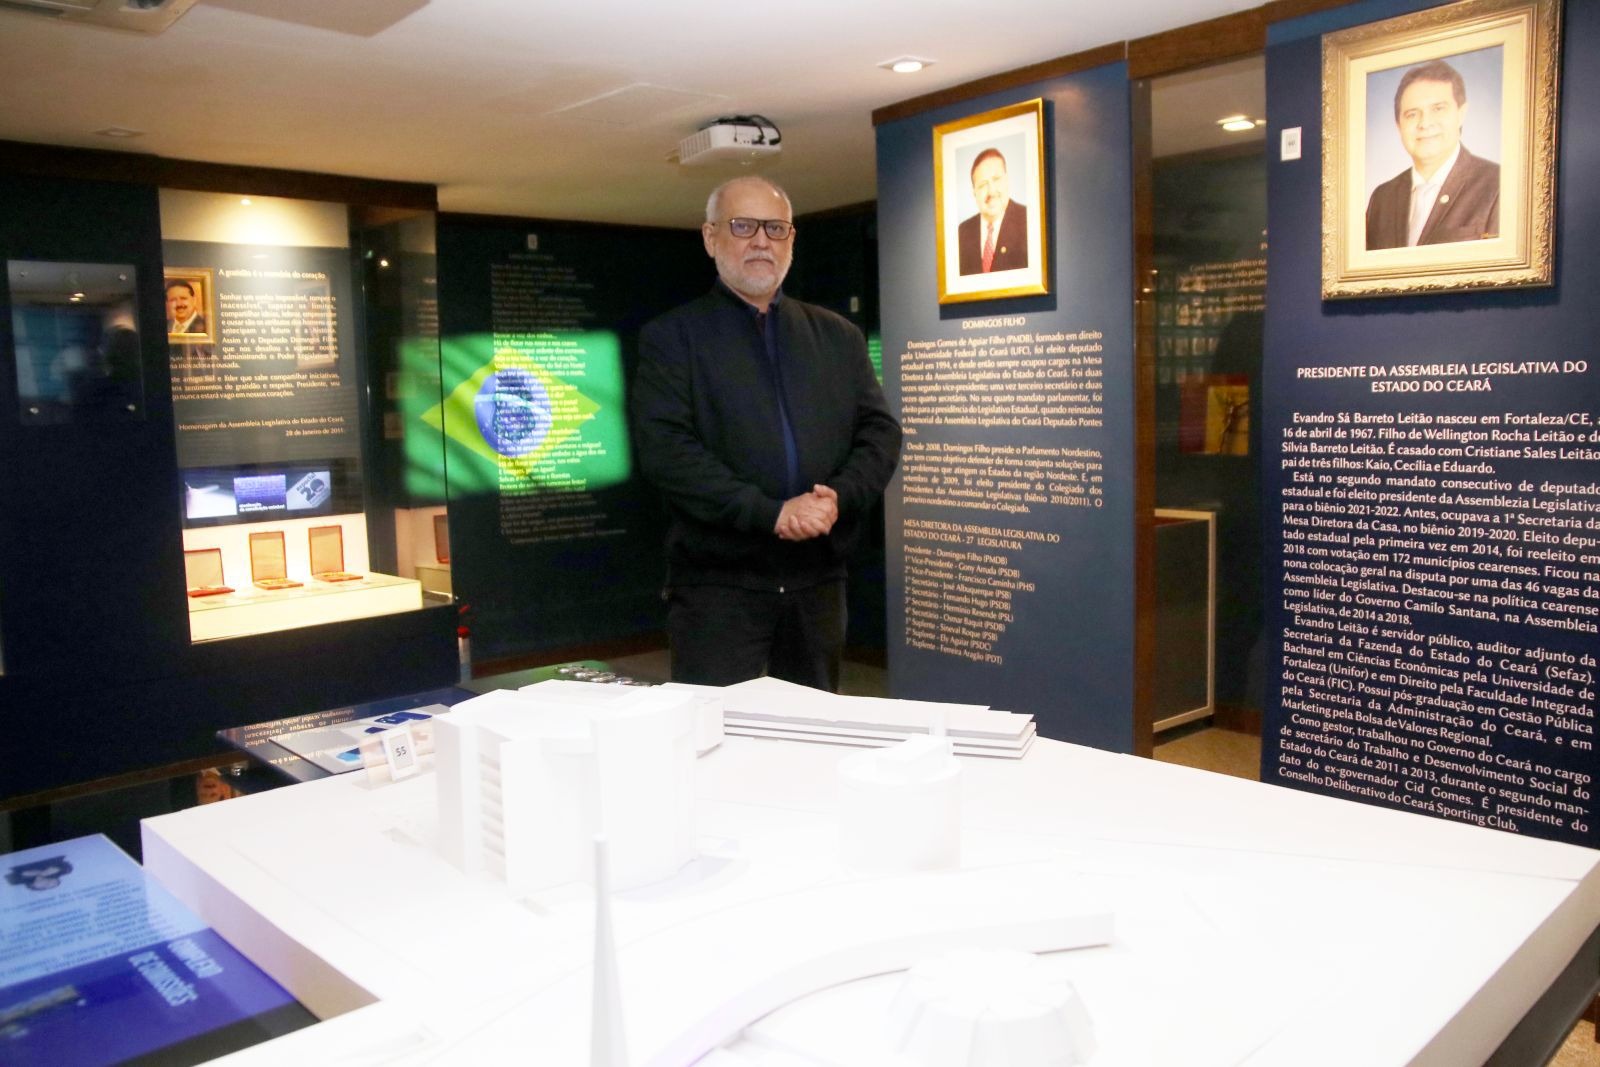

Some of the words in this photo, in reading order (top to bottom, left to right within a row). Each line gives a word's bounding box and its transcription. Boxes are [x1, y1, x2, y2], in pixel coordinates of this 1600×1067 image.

[962, 318, 1002, 329] DOMINGOS
[1003, 316, 1025, 326] FILHO
[1297, 366, 1366, 378] PRESIDENTE
[1369, 365, 1386, 376] DA
[1389, 363, 1467, 376] ASSEMBLEIA
[1471, 361, 1558, 374] LEGISLATIVA
[1563, 360, 1587, 372] DO
[1371, 380, 1419, 392] ESTADO
[1423, 380, 1443, 391] DO
[1446, 377, 1491, 391] CEARÁ
[1293, 412, 1334, 423] Evandro
[1337, 412, 1350, 423] Sá
[1354, 412, 1394, 423] Barreto
[1398, 412, 1432, 423] Leitão
[1436, 415, 1476, 424] nasceu
[1480, 415, 1499, 424] em
[1504, 412, 1592, 425] Fortaleza/CE,
[1283, 427, 1293, 437] 16
[1294, 426, 1307, 437] de
[1309, 426, 1331, 438] abril
[1334, 427, 1346, 438] de
[1350, 428, 1375, 438] 1967.
[1378, 427, 1406, 439] Filho
[1408, 427, 1422, 439] de
[1423, 428, 1488, 443] Wellington
[1491, 429, 1530, 441] Rocha
[1533, 430, 1574, 441] Leitão
[1577, 433, 1585, 442] e
[1588, 429, 1600, 442] d
[1282, 441, 1308, 452] Sílvia
[1310, 442, 1348, 453] Barreto
[1350, 443, 1385, 454] Leitão.
[1388, 442, 1394, 454] É
[1396, 444, 1436, 456] casado
[1438, 448, 1462, 457] com
[1464, 445, 1521, 458] Cristiane
[1523, 446, 1556, 459] Sales
[1282, 456, 1296, 469] pai
[1298, 456, 1310, 467] de
[1311, 457, 1330, 468] três
[1332, 457, 1363, 469] filhos:
[1365, 458, 1392, 471] Kaio,
[1393, 459, 1432, 471] Cecília
[1433, 463, 1440, 471] e
[1442, 460, 1494, 473] Eduardo.
[1293, 471, 1314, 482] Está
[1319, 474, 1332, 483] no
[1336, 473, 1381, 486] segundo
[1386, 475, 1436, 487] mandato
[1441, 479, 1512, 490] consecutivo
[1518, 479, 1533, 491] de
[1282, 486, 1323, 497] estadual
[1324, 490, 1330, 498] e
[1332, 487, 1346, 498] foi
[1347, 488, 1377, 499] eleito
[1378, 490, 1436, 503] presidente
[1438, 492, 1452, 504] da
[1455, 494, 1529, 508] Assemblezia
[1283, 528, 1304, 539] tado
[1307, 531, 1349, 543] estadual
[1353, 534, 1374, 546] pela
[1378, 536, 1424, 549] primeira
[1428, 542, 1446, 551] vez
[1450, 544, 1468, 552] em
[1472, 543, 1502, 557] 2014,
[1506, 545, 1522, 557] foi
[1527, 548, 1575, 561] reeleito
[1579, 554, 1600, 564] em
[1283, 572, 1337, 586] Assembleia
[1340, 577, 1398, 592] Legislativa.
[1402, 583, 1470, 600] Destacou-se
[1473, 594, 1488, 603] na
[1492, 594, 1537, 608] política
[1541, 601, 1598, 615] cearense
[1284, 599, 1337, 616] Legislativa,
[1338, 606, 1350, 617] de
[1352, 608, 1375, 620] 2014
[1377, 613, 1383, 621] a
[1385, 612, 1411, 624] 2018.
[1283, 627, 1332, 643] Secretaria
[1339, 635, 1351, 646] da
[1358, 638, 1402, 654] Fazenda
[1409, 645, 1423, 657] do
[1430, 648, 1469, 663] Estado
[1476, 655, 1492, 667] do
[1499, 658, 1537, 674] Ceará
[1545, 665, 1594, 684] (Sefaz).
[395, 746, 407, 757] 55
[1291, 713, 1320, 727] Como
[1322, 721, 1354, 735] gestor,
[1357, 727, 1407, 744] trabalhou
[1410, 739, 1424, 748] no
[1426, 740, 1474, 758] Governo
[1477, 750, 1492, 762] do
[1495, 754, 1531, 770] Ceará
[1535, 764, 1551, 774] no
[1554, 768, 1590, 784] cargo
[1278, 766, 1323, 784] Conselho
[1325, 776, 1386, 799] Deliberativo
[1387, 791, 1400, 802] do
[1402, 794, 1434, 811] Ceará
[1436, 802, 1485, 825] Sporting
[1487, 815, 1518, 831] Club.
